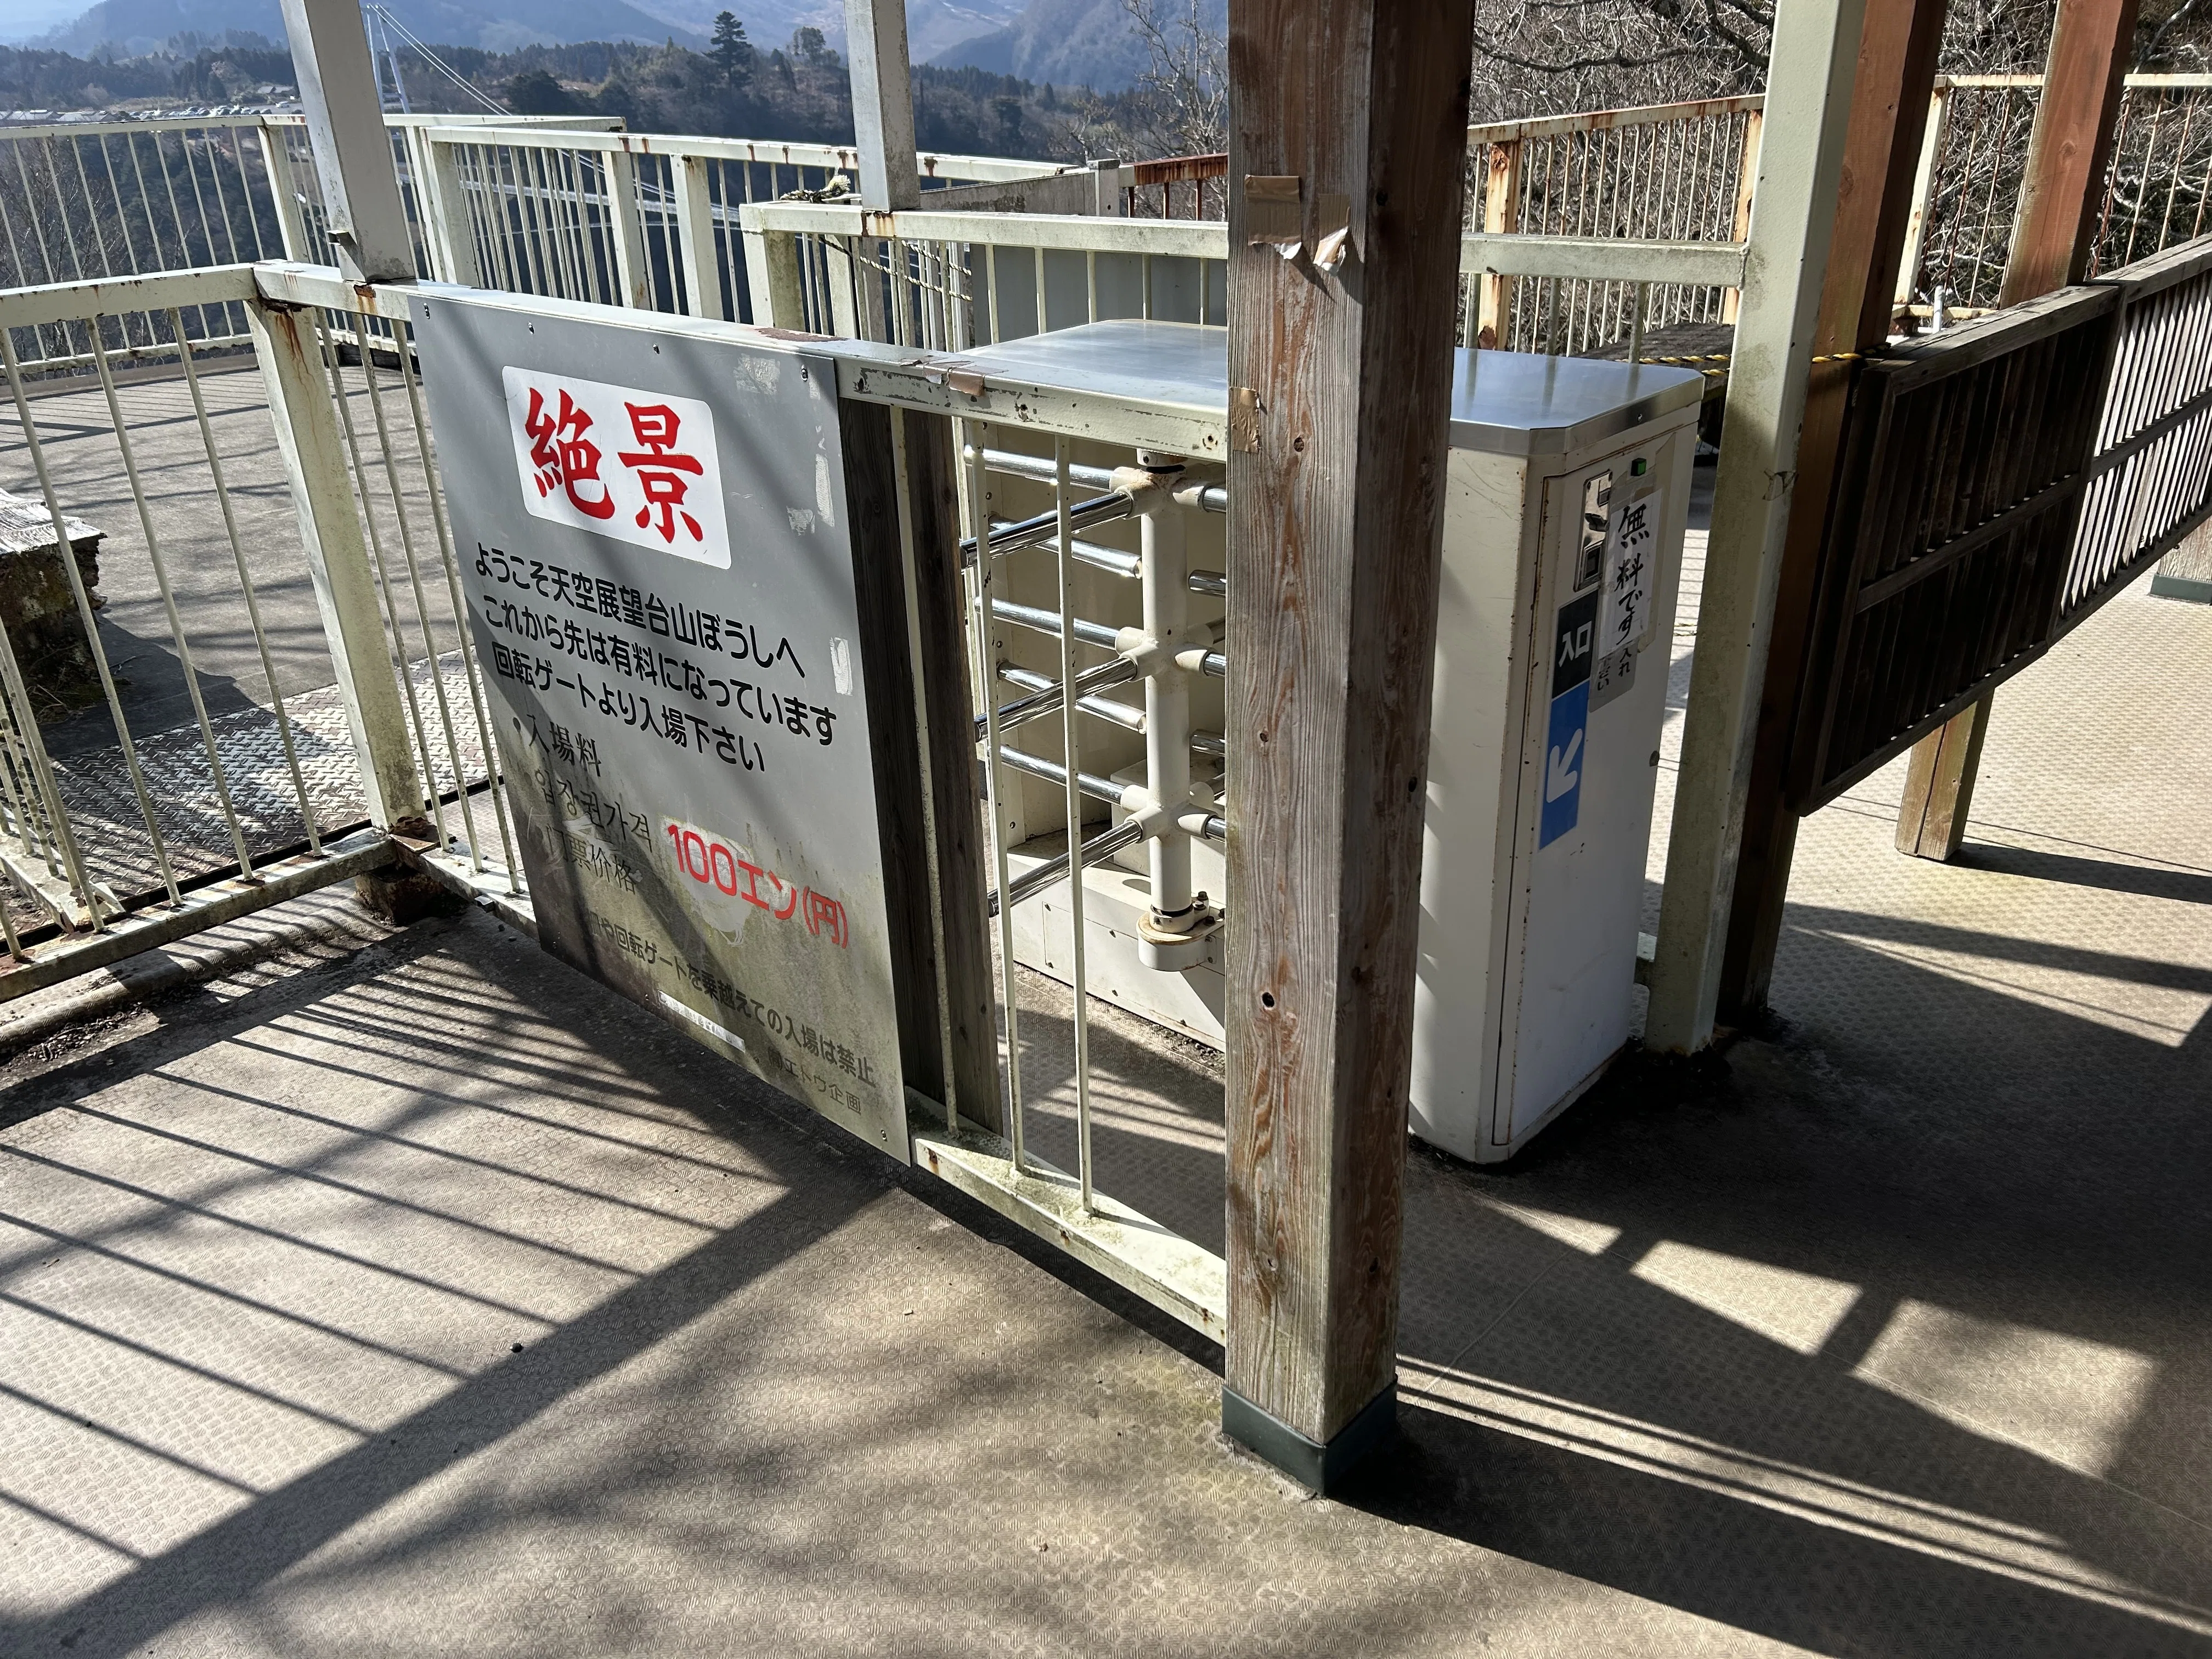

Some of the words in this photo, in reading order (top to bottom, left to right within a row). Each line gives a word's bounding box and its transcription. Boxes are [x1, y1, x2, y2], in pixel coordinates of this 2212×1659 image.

[524, 387, 704, 544] 絶景
[475, 542, 806, 678] ようこそ天空展望台山ぼうしへ
[1615, 504, 1650, 646] 無料です
[484, 595, 838, 746] これから先は有料になっています
[491, 641, 766, 772] 回転ゲートより入場下さい
[1559, 620, 1592, 668] 入口
[527, 713, 602, 777] 入場料
[668, 824, 849, 949] 100エン(円)
